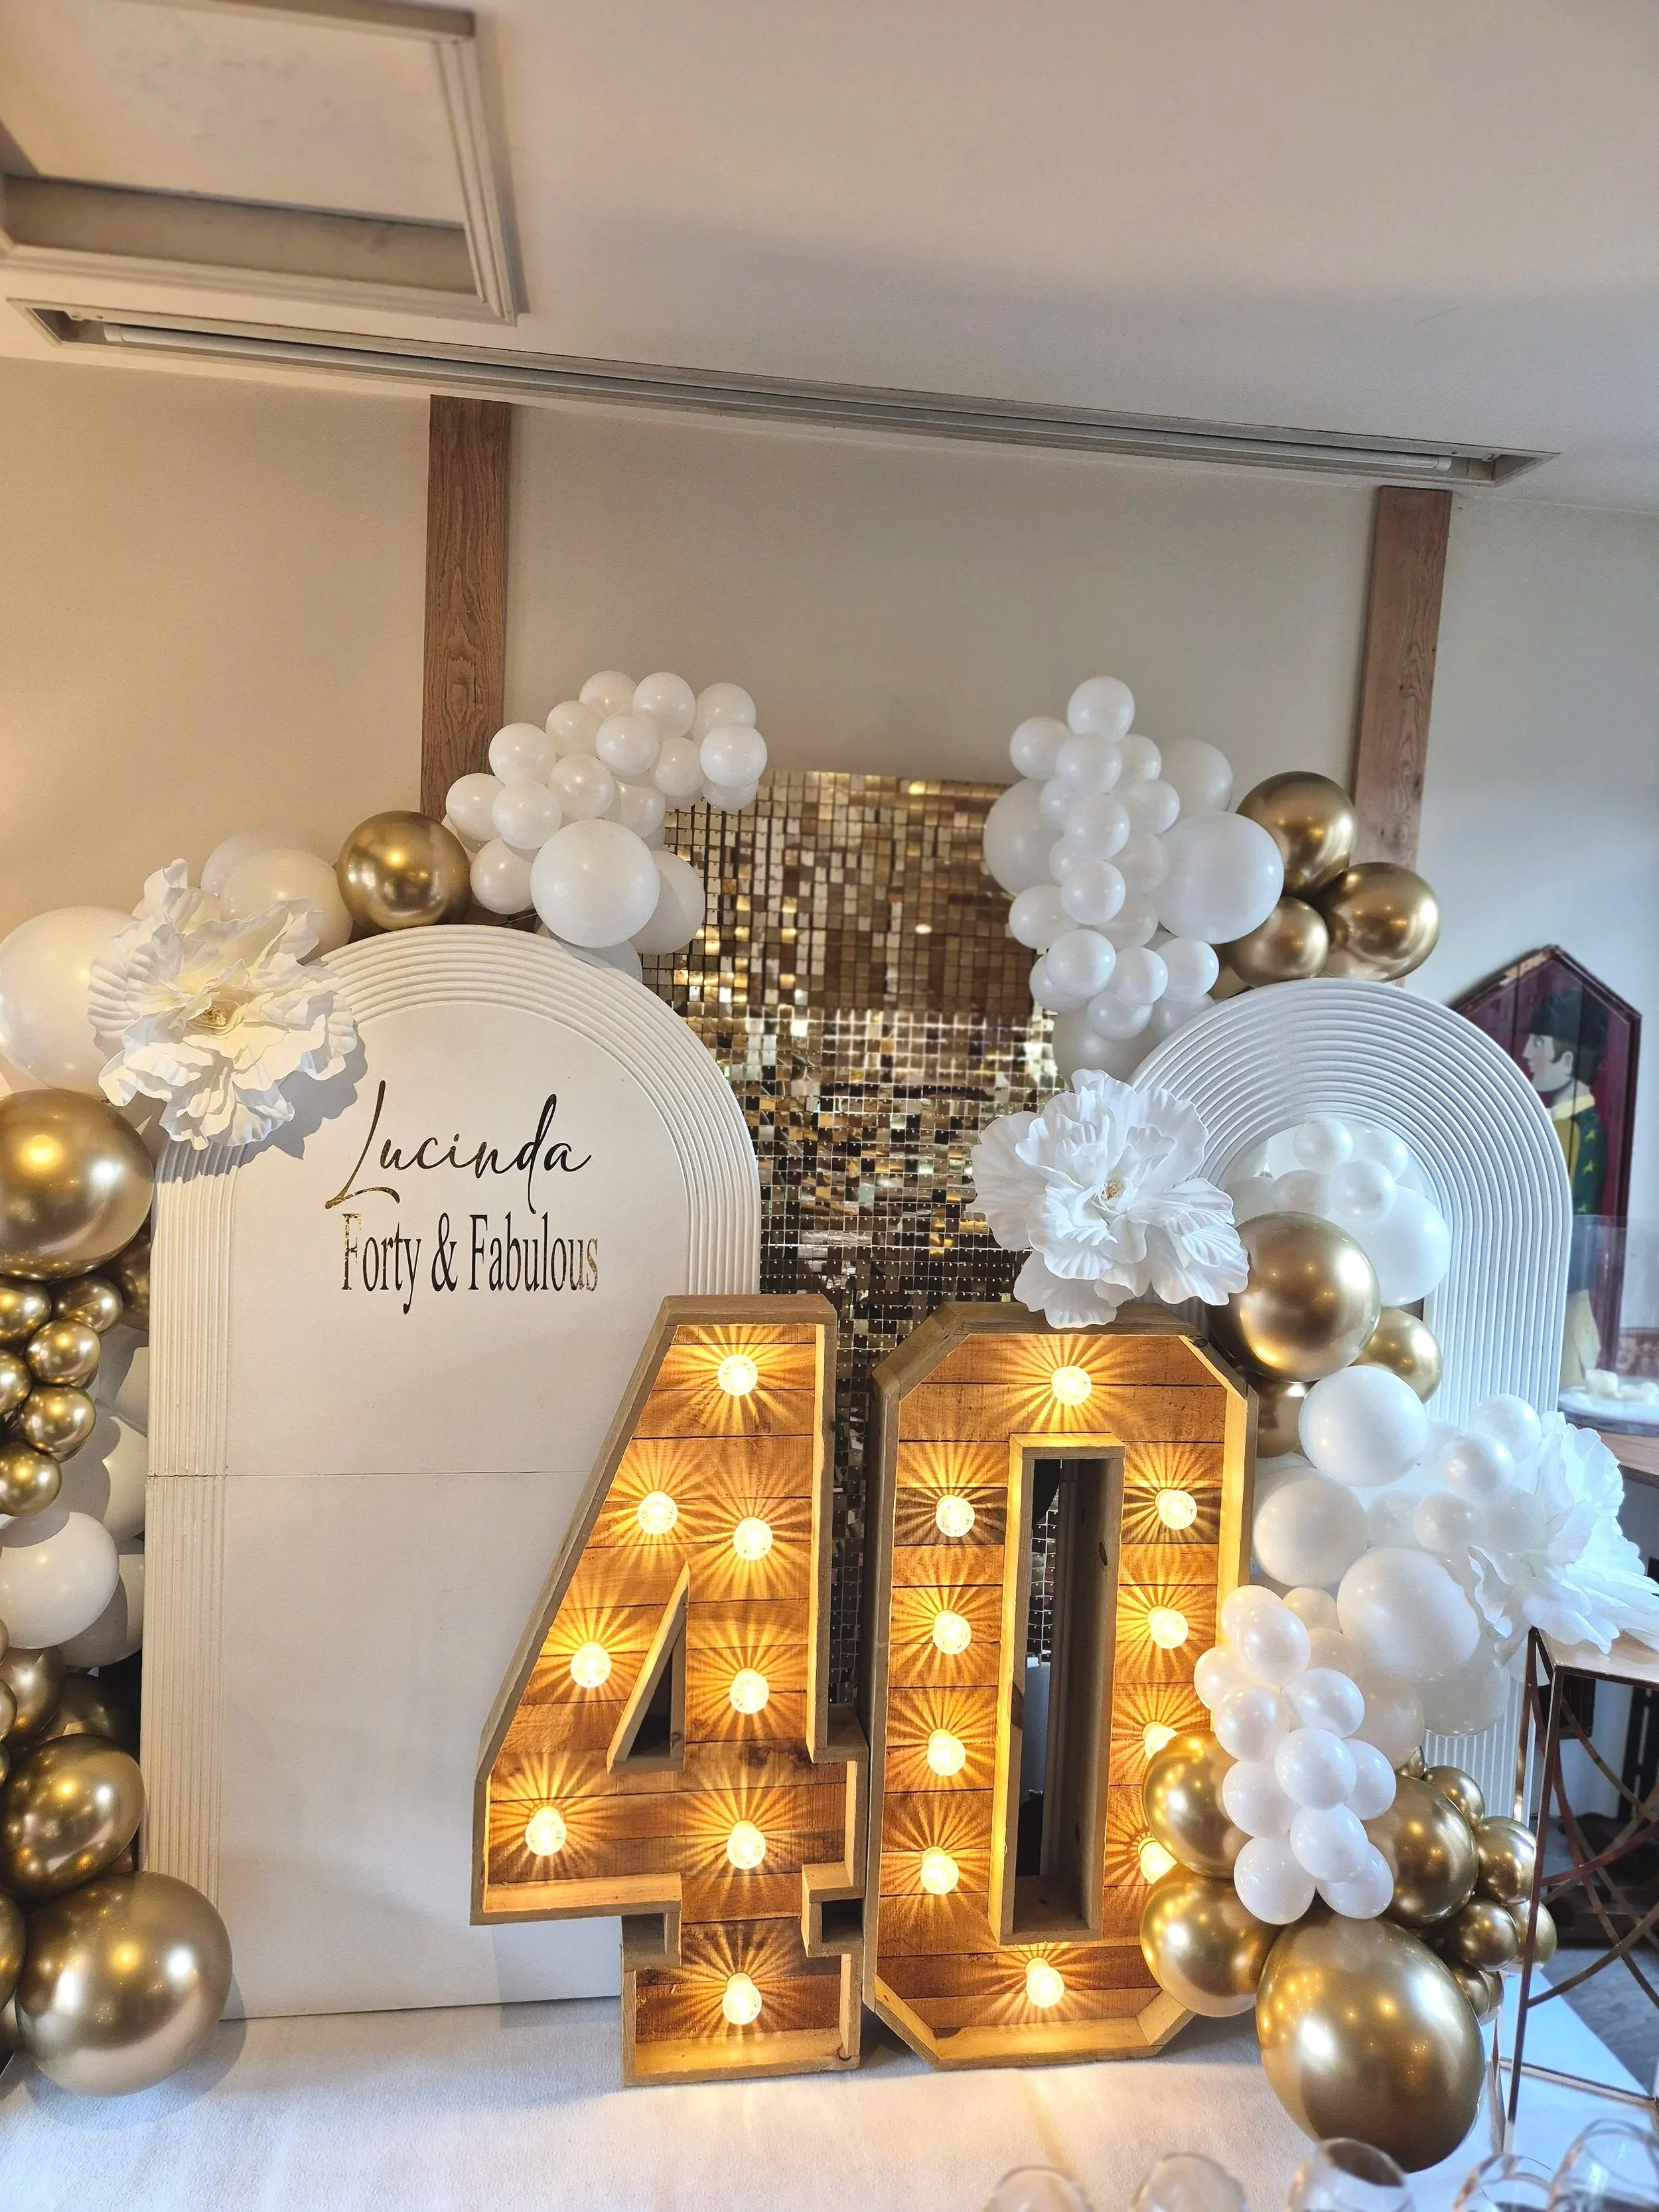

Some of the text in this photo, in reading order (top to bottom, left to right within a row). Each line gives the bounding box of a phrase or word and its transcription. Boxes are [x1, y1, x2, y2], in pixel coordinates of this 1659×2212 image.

[325, 1080, 592, 1214] Lucinda
[341, 1211, 599, 1315] Forty & Fabulous
[469, 1293, 1258, 2087] 40
